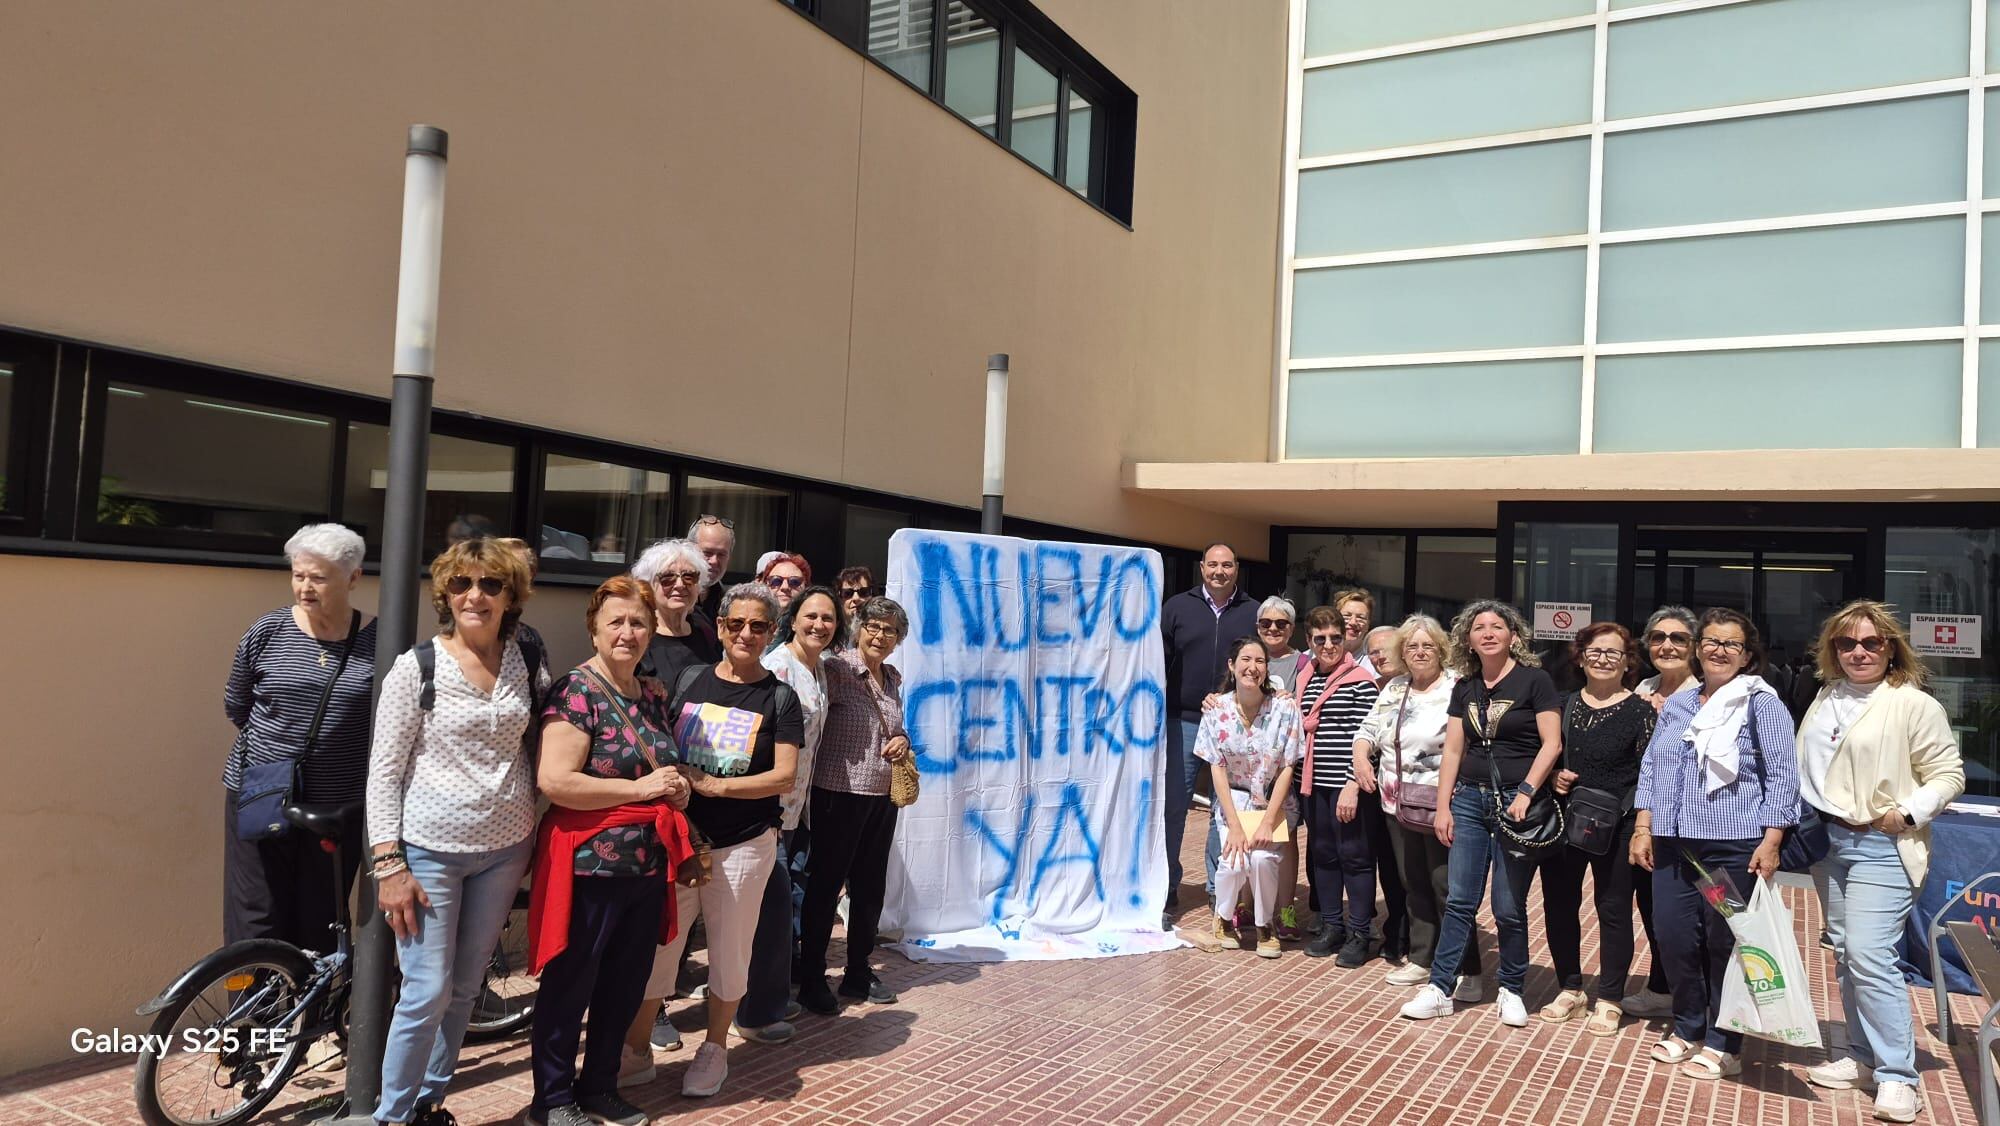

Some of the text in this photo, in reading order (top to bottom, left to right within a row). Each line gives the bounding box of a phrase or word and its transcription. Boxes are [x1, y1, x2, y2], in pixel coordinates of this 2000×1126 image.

[915, 541, 1158, 650] NUEVO
[1916, 615, 1936, 623] ESPAI
[1937, 616, 1959, 624] SENSE
[905, 675, 1165, 774] CENTRO
